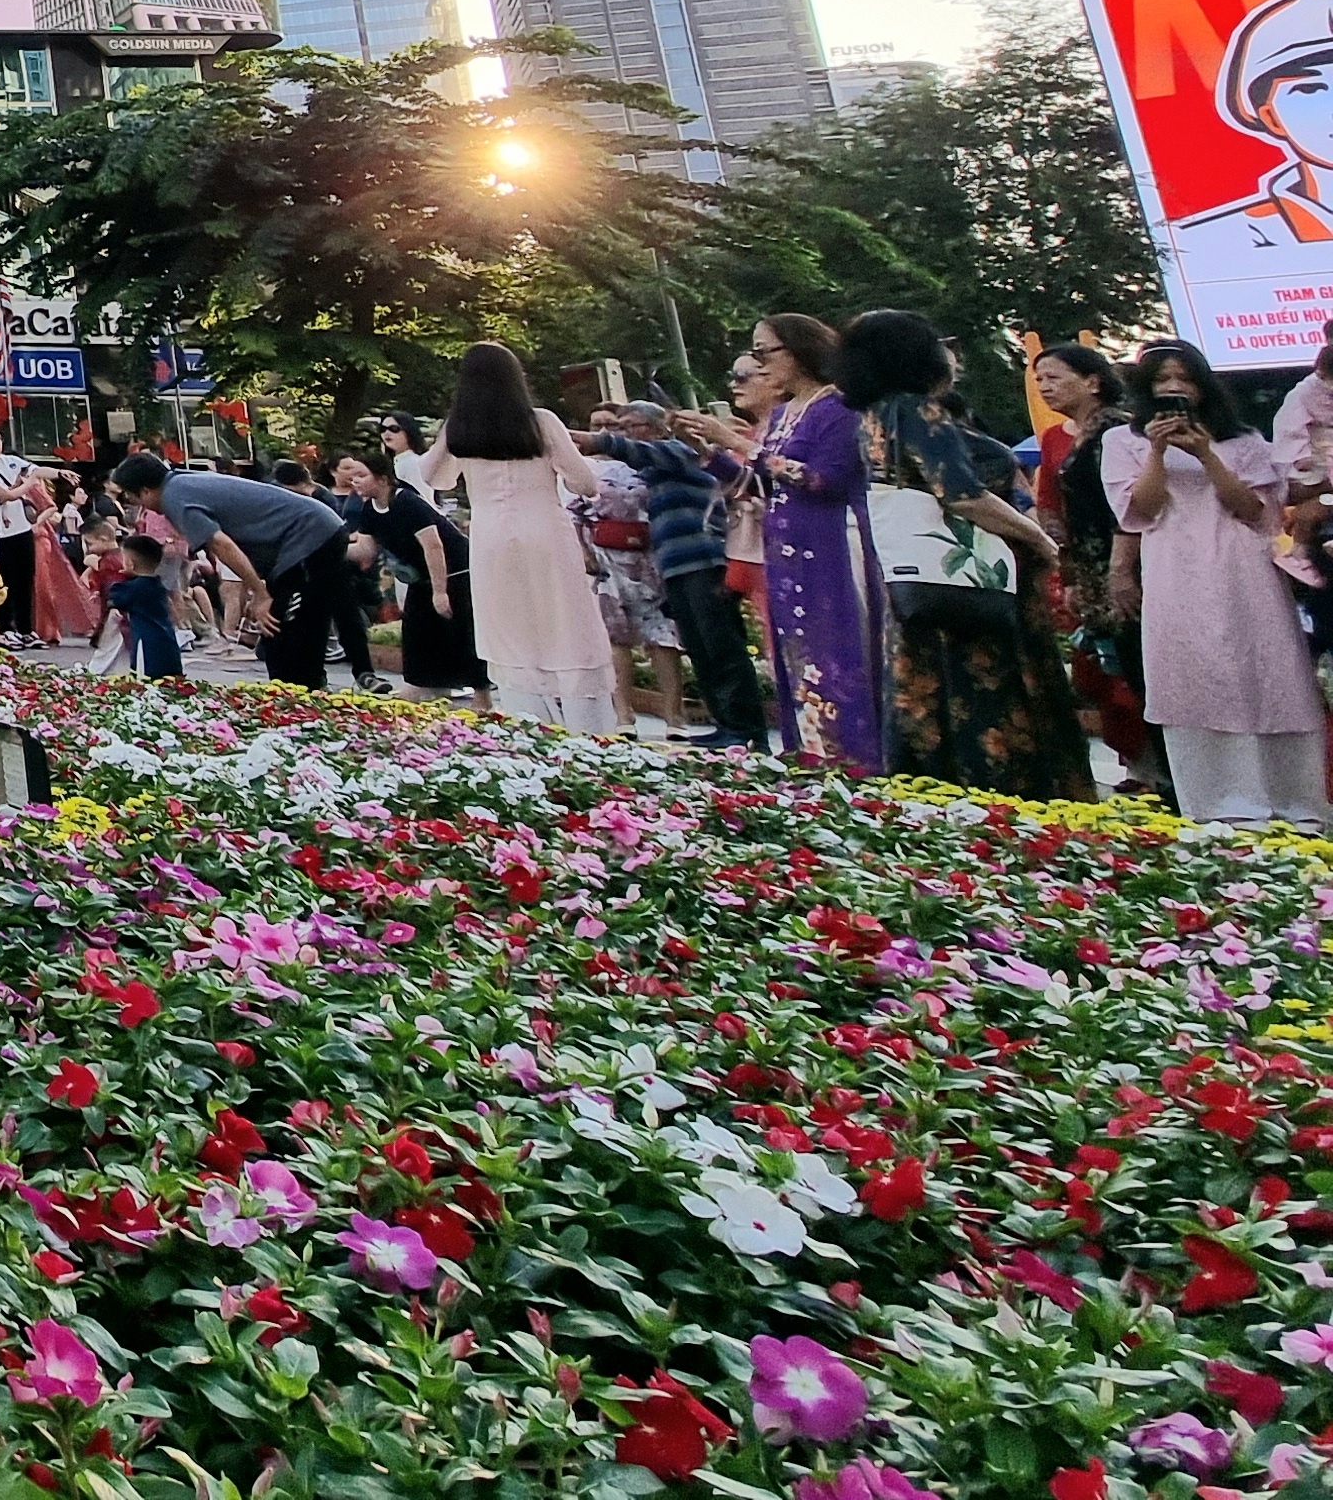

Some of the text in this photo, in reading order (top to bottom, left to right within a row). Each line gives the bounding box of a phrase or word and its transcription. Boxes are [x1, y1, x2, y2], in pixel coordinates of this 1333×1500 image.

[109, 38, 214, 50] GOLDSUN MEDIA
[830, 41, 895, 57] FUSION
[1274, 286, 1333, 302] THAM GI
[1215, 307, 1328, 329] VÀ ĐẠI BIỂU HỘI
[1227, 334, 1247, 349] LÀ
[18, 358, 75, 380] UOB
